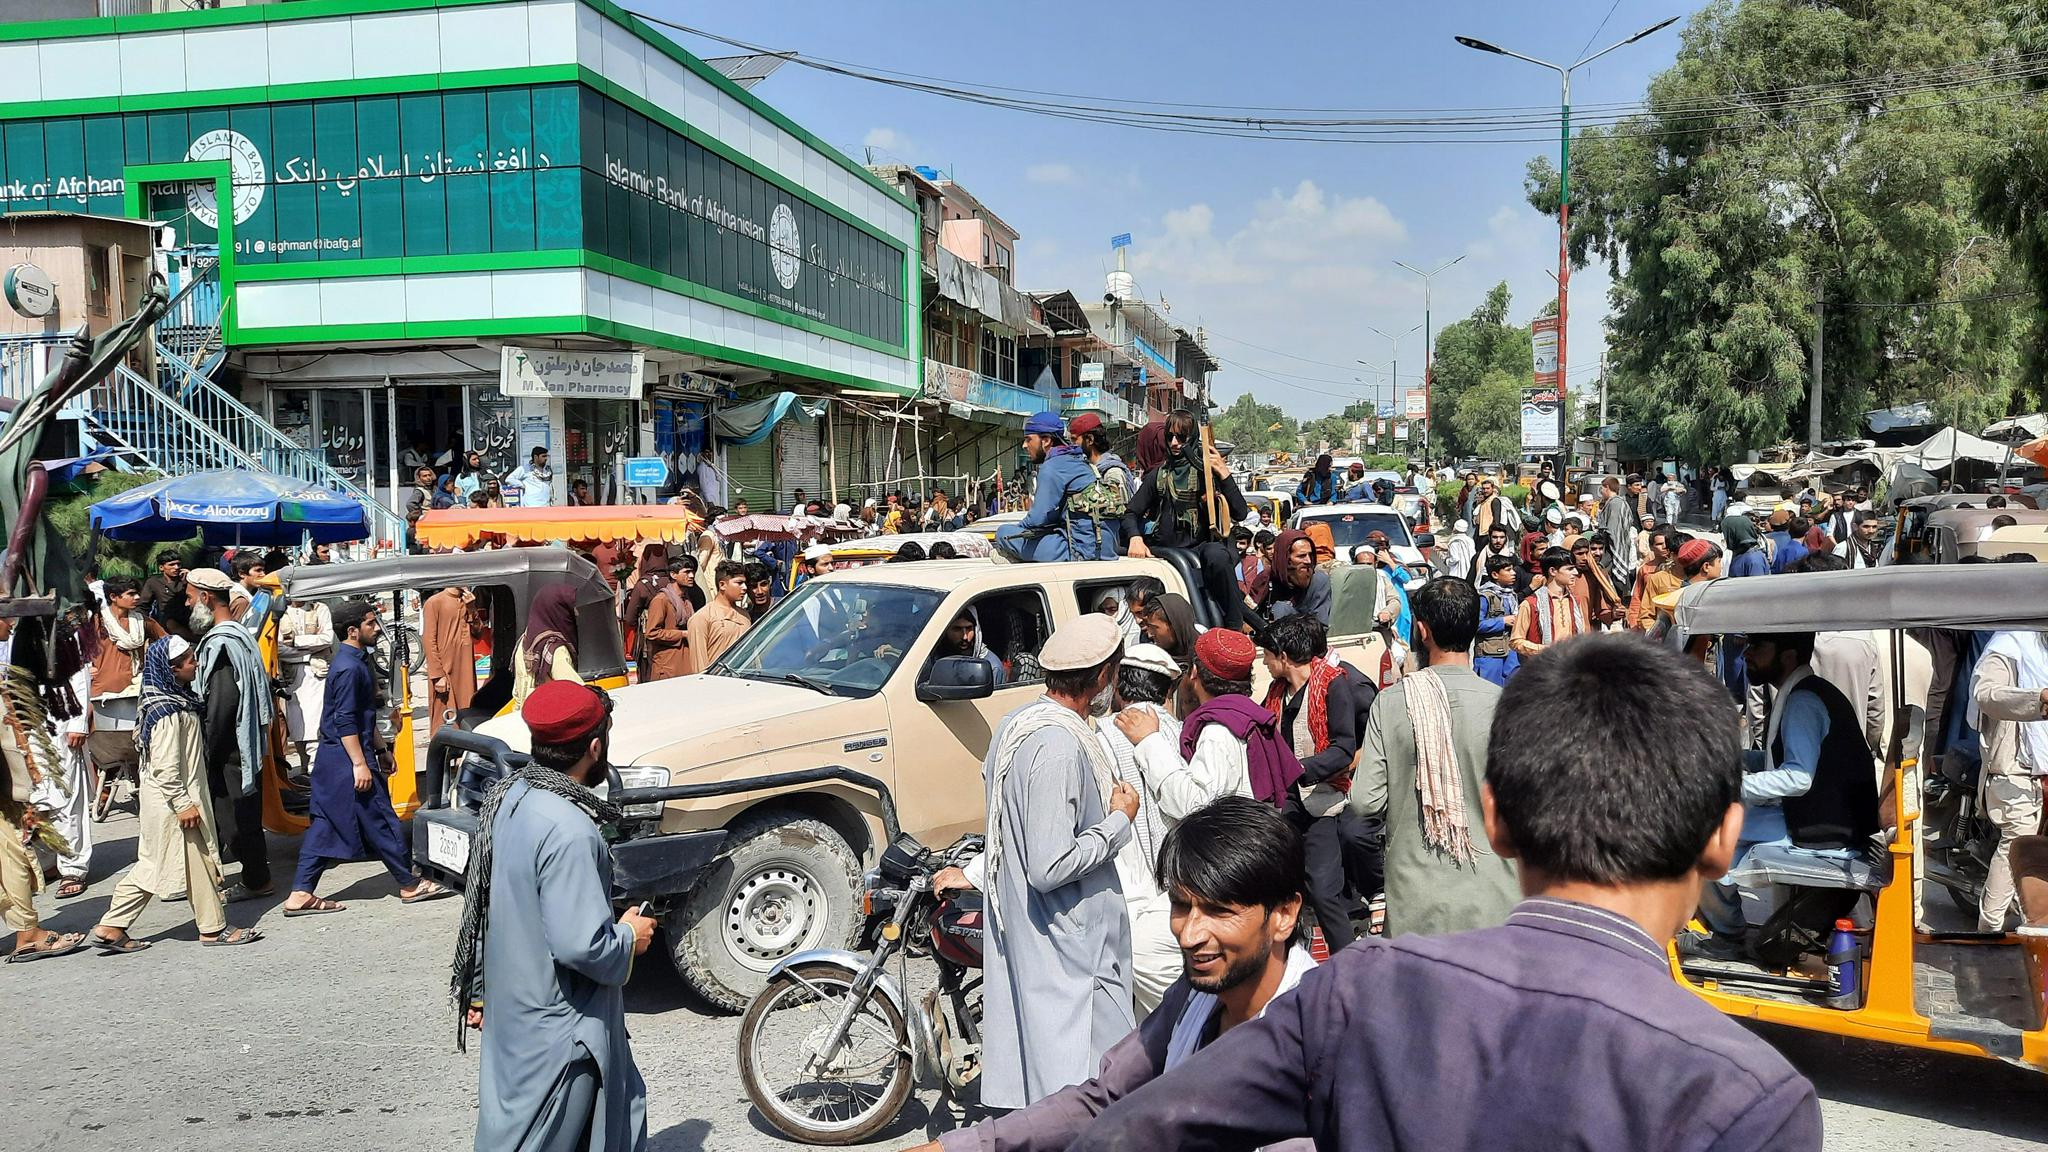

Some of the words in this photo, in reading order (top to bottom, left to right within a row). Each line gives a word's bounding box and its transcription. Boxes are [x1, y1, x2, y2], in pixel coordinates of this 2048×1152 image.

[194, 132, 248, 153] ISLAMIC
[247, 150, 263, 191] BANK
[537, 153, 551, 172] د
[275, 157, 327, 191] بانک
[244, 196, 257, 214] OF
[605, 152, 654, 200] Islamic
[656, 176, 689, 215] Bank
[691, 194, 704, 220] of
[705, 198, 765, 243] Afghanistan
[568, 382, 631, 395] Pharmacy
[203, 504, 269, 520] Alokozay
[844, 737, 888, 752] RANGER
